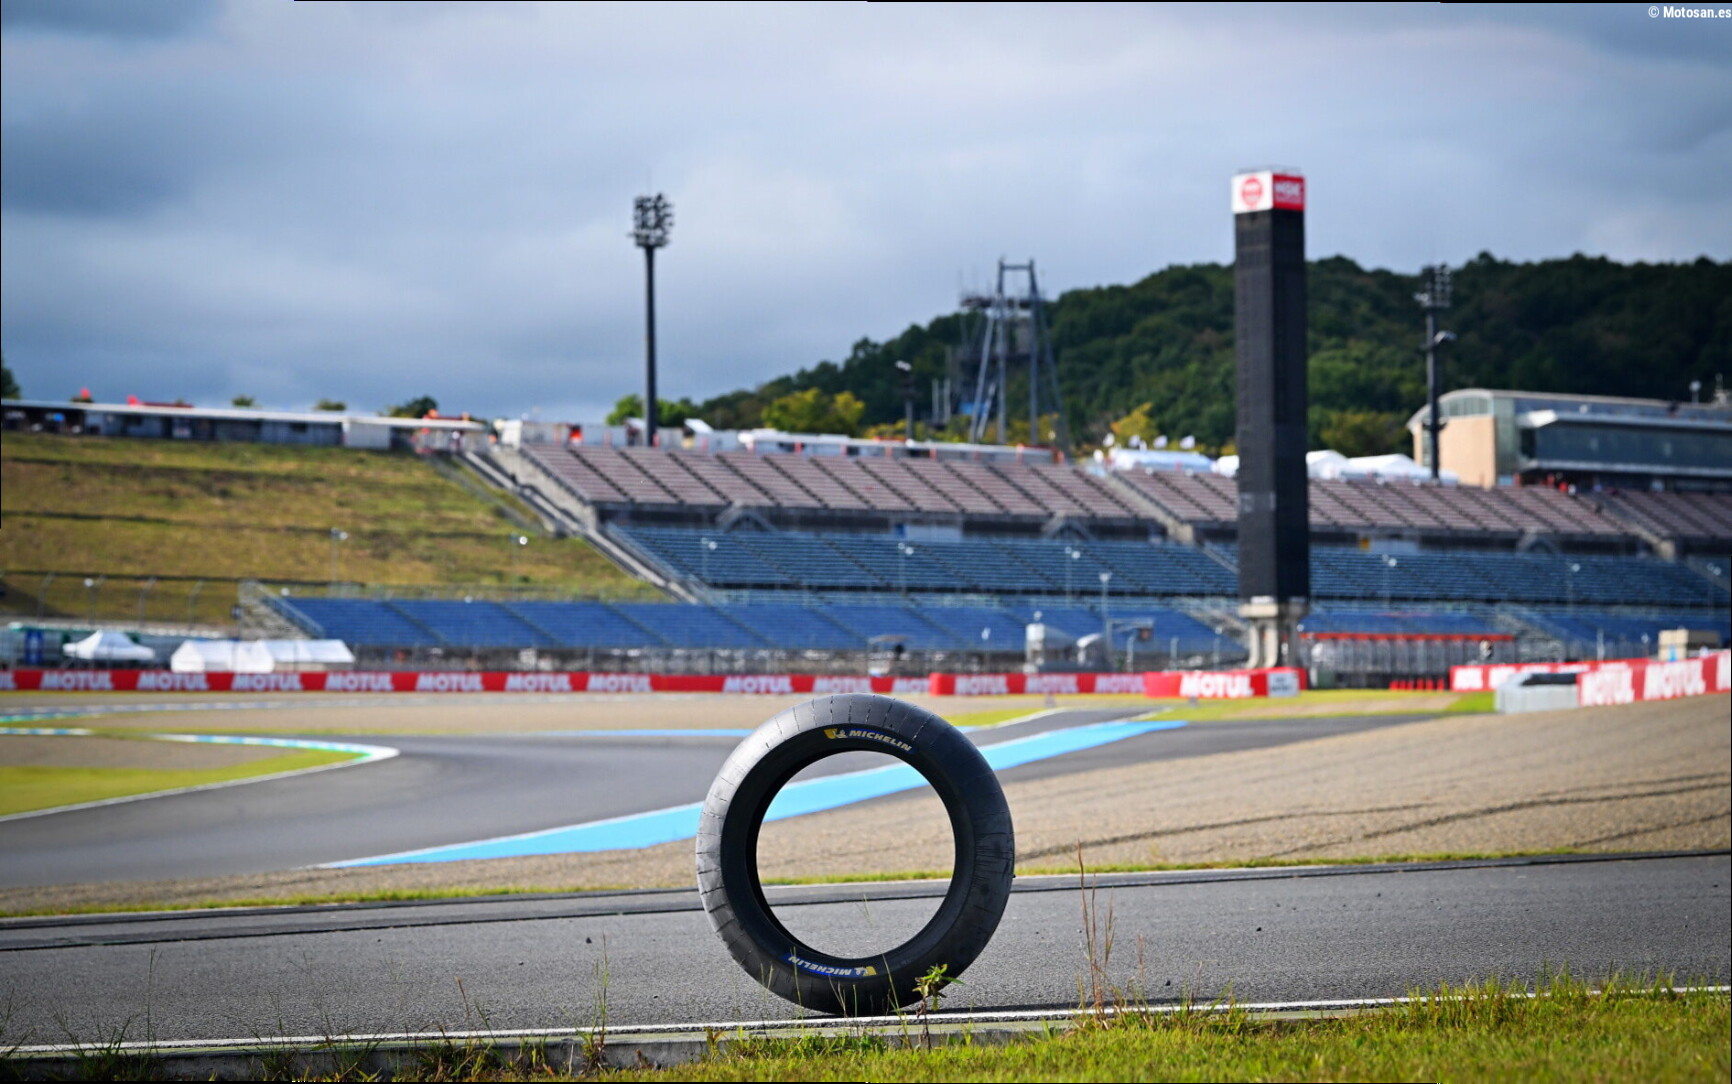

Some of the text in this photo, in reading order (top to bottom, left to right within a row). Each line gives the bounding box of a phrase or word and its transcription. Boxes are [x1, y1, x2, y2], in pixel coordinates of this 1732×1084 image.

[40, 672, 113, 690] MOTUL
[136, 672, 210, 690] MOTUL
[231, 673, 304, 691] MOTUL
[325, 673, 393, 691] MOTUL
[415, 674, 484, 691] MOTUL
[504, 674, 573, 692] MOTUL
[586, 675, 654, 692] MOTUL
[722, 676, 793, 693] MOTUL
[954, 674, 1008, 694] MOTUL
[1025, 675, 1078, 693] MOTUL
[1180, 673, 1254, 698] MOTUL
[1643, 660, 1706, 700] MOTUL
[849, 730, 912, 752] MICHELIN
[788, 956, 852, 976] MICHELIN
